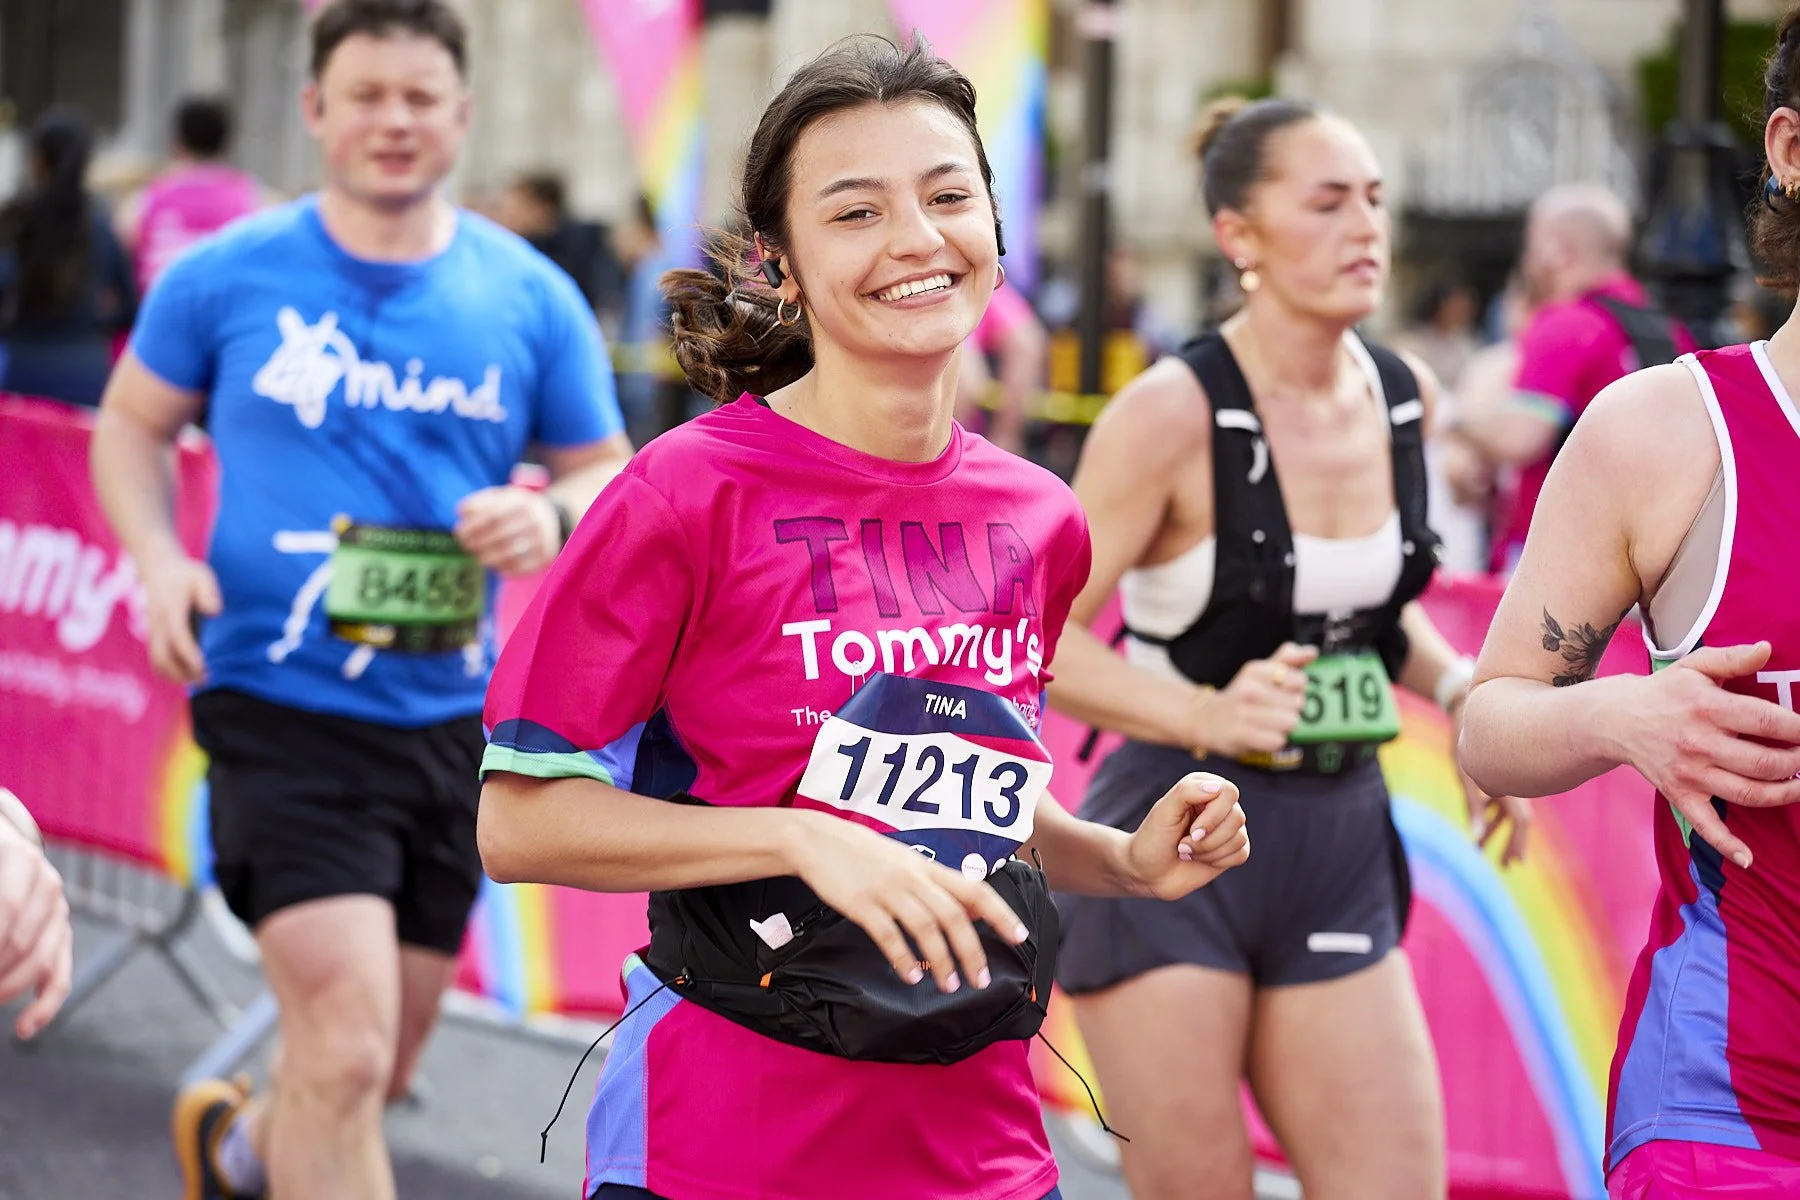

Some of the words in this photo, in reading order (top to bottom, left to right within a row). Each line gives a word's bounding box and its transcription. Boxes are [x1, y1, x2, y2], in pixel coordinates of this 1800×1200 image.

[345, 357, 508, 423] mind
[773, 516, 1038, 618] TINA
[781, 618, 1042, 686] Tommy's
[791, 705, 832, 726] The
[925, 693, 967, 720] TINA
[837, 736, 1029, 828] 11213
